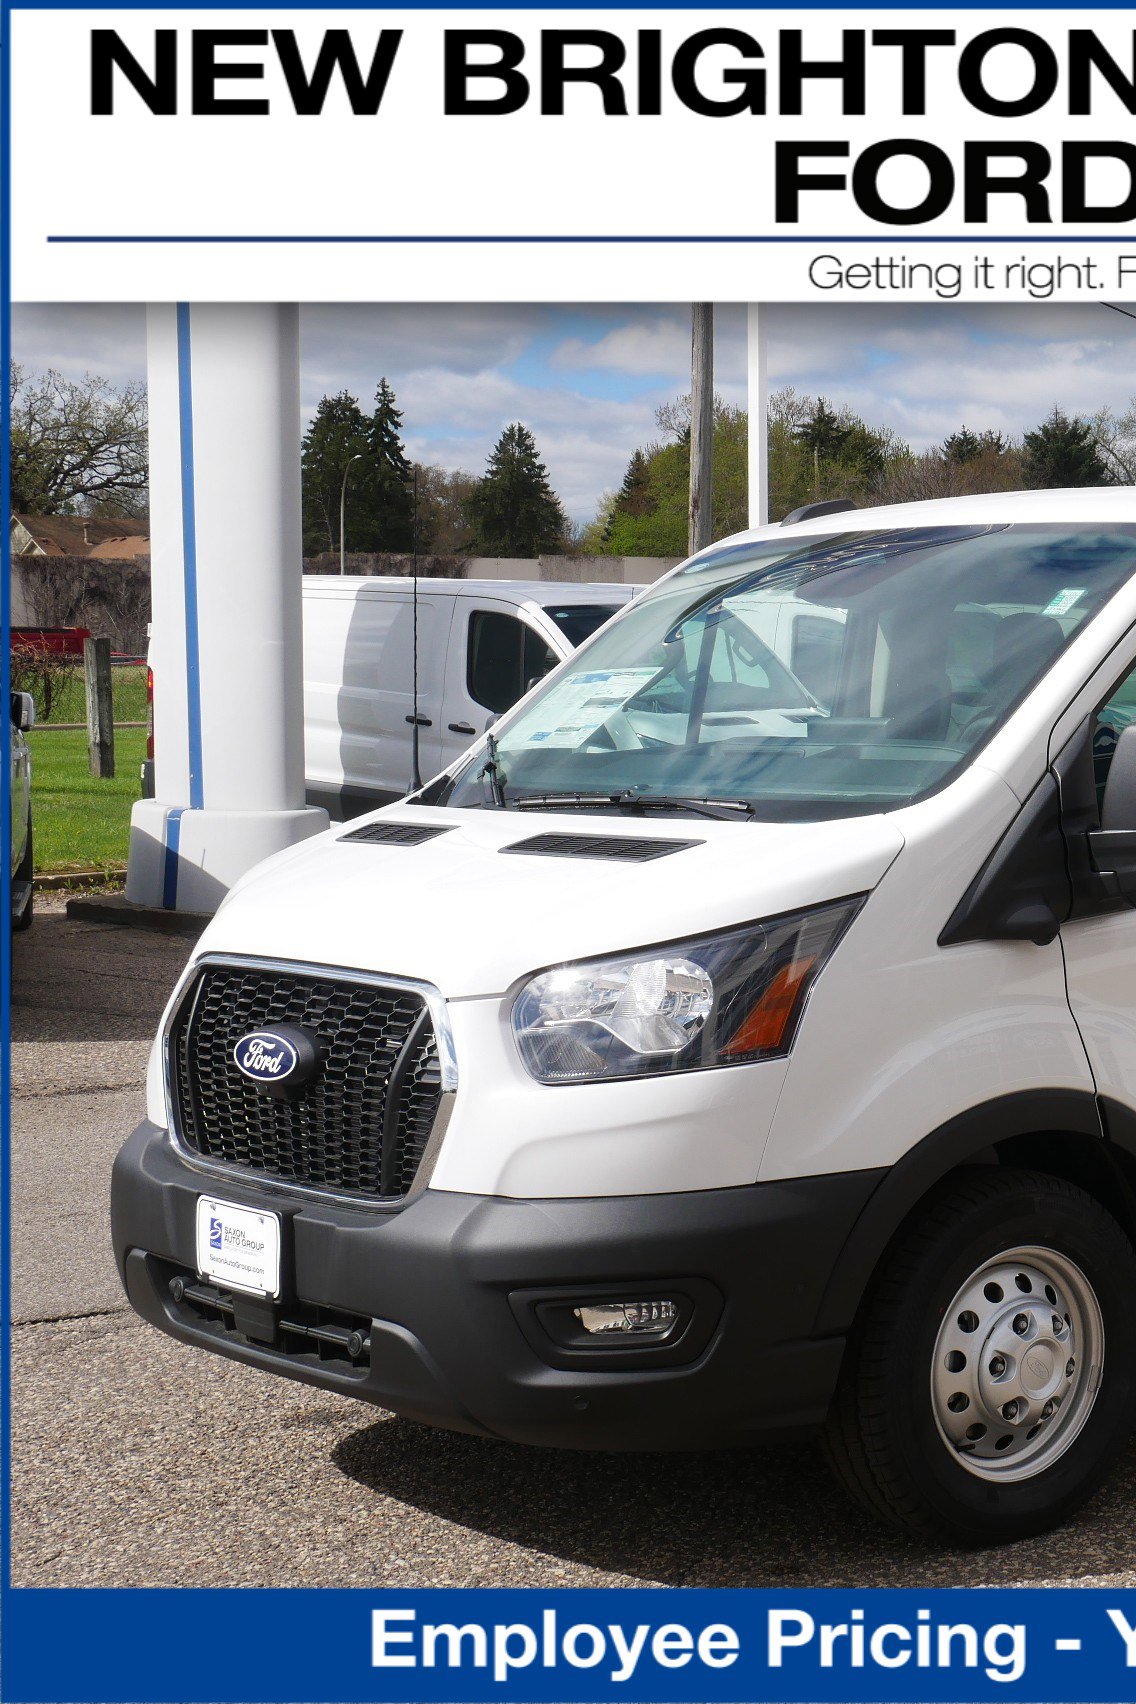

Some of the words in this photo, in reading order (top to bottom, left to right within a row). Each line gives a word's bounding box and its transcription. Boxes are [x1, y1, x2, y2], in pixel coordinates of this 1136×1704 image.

[243, 1039, 284, 1073] Ford
[224, 1226, 245, 1238] SAXON
[224, 1235, 240, 1246] AUTO
[241, 1239, 265, 1251] GROUP
